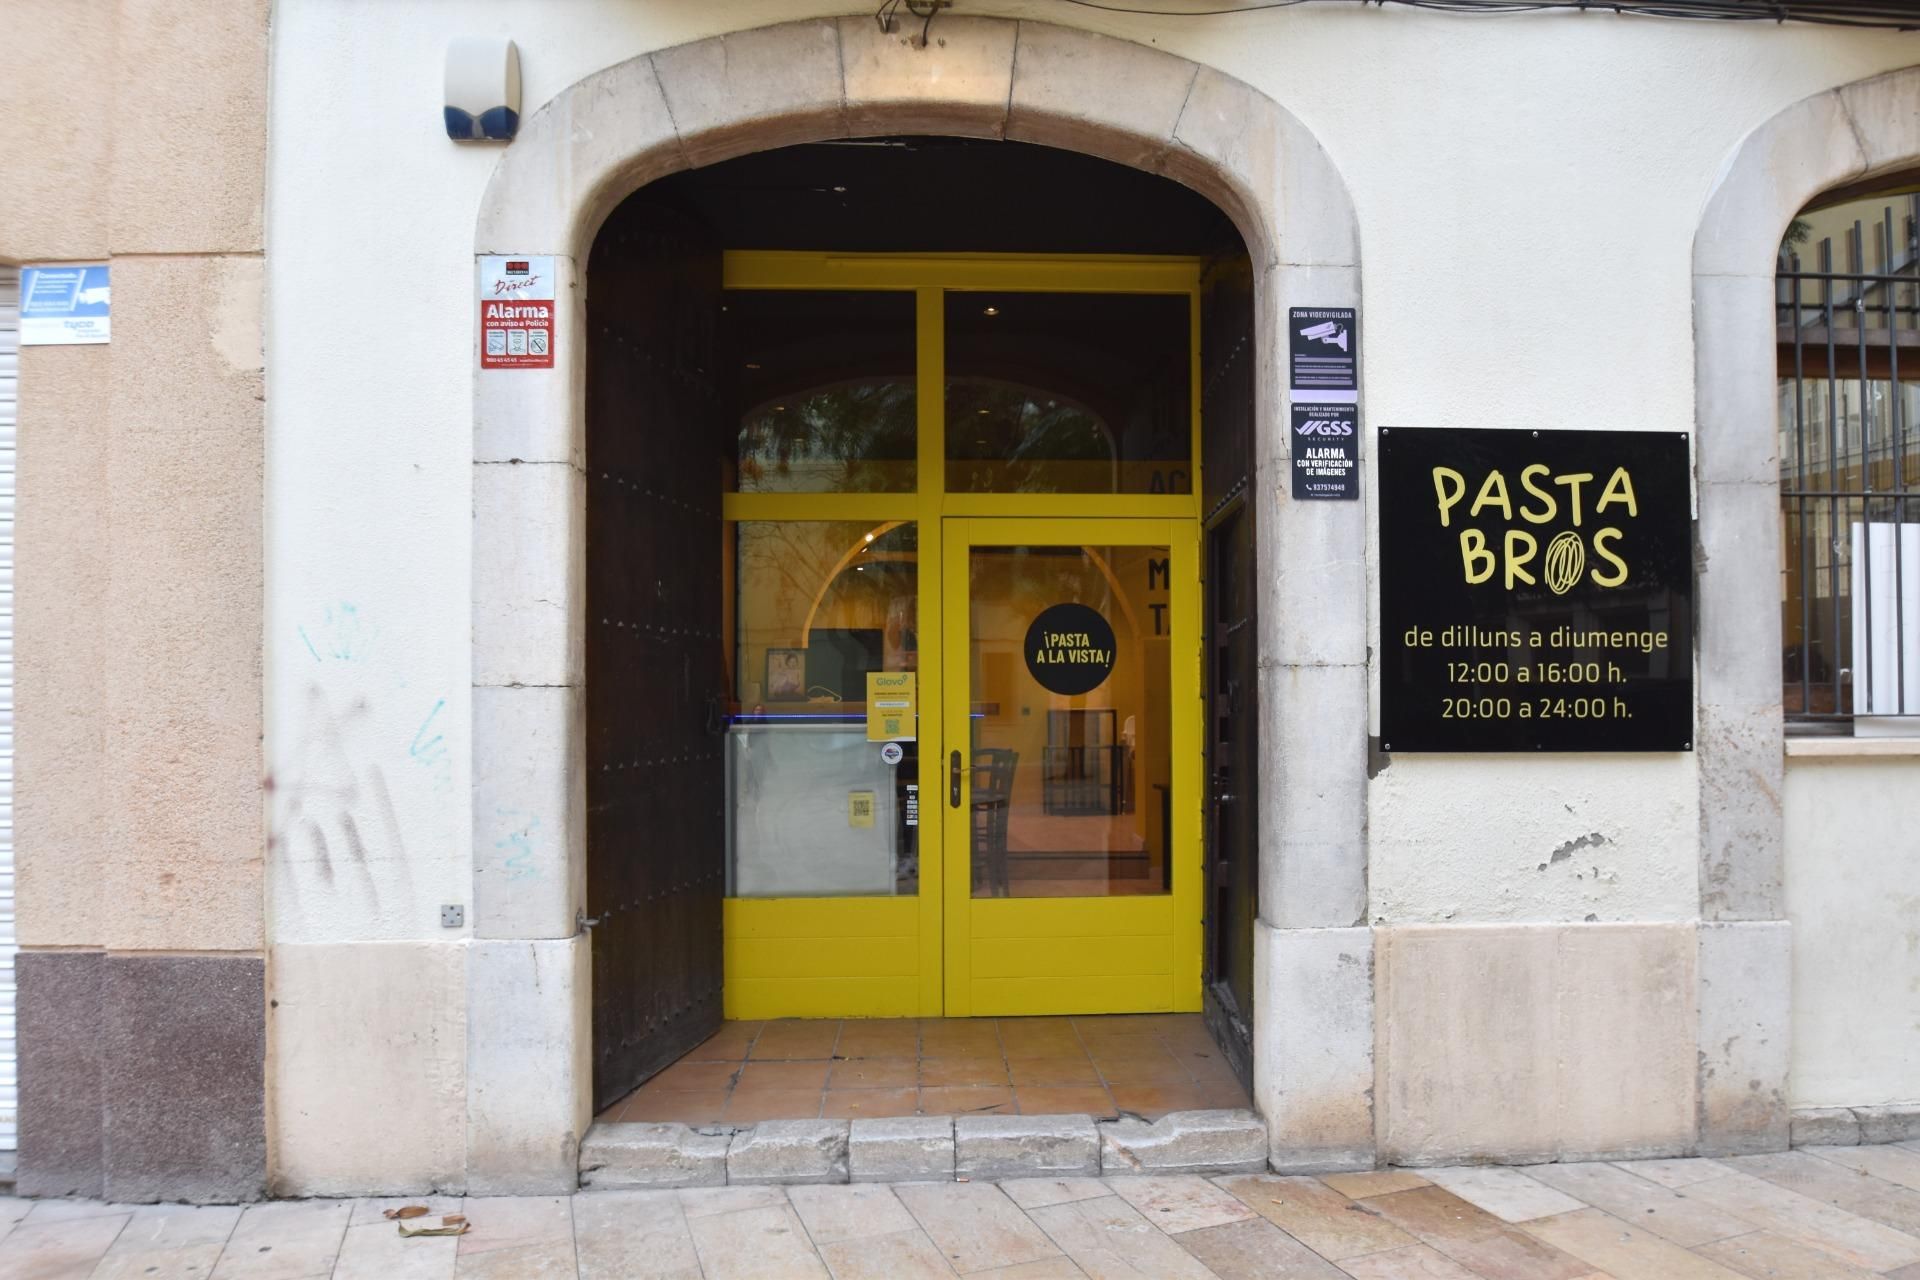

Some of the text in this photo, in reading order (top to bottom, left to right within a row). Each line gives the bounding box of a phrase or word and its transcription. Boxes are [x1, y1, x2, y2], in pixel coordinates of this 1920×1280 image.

[494, 275, 541, 295] Direct
[487, 303, 549, 318] Alarma
[1316, 420, 1352, 436] GSS
[1306, 448, 1345, 459] ALARMA
[1306, 467, 1346, 476] DE IMÁGENES
[1311, 459, 1353, 467] VERIFICACIÓN
[1433, 464, 1637, 526] PASTA
[1460, 527, 1628, 594] BROS
[1044, 631, 1090, 649] ¡PASTA
[1404, 625, 1668, 653] de dilluns a diumenge
[1037, 650, 1110, 668] A LA VISTA!
[876, 676, 906, 686] Glovo
[1448, 661, 1627, 683] 12:00 a 16:00 h.
[1442, 697, 1632, 718] 20:00 a 24:00 h.
